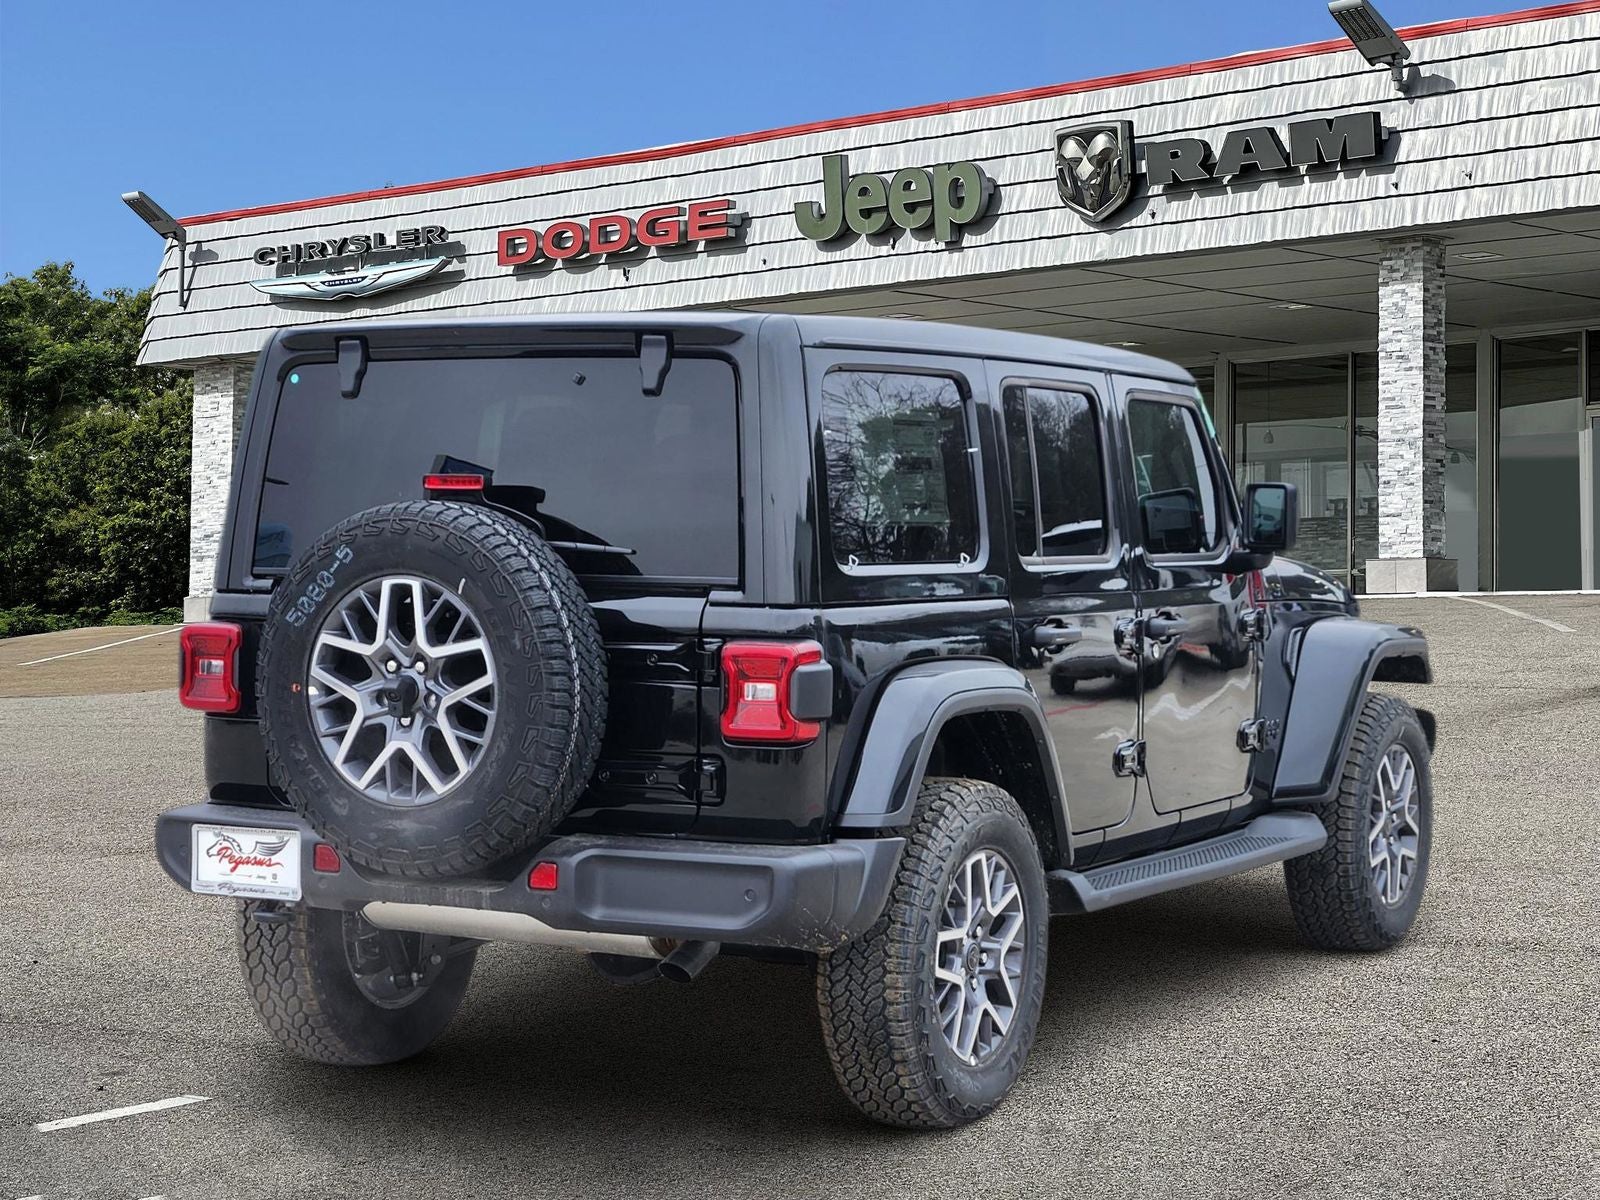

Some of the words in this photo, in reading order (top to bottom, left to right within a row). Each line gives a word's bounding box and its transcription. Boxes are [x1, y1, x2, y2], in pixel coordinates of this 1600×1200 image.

[1145, 111, 1381, 187] RAM
[795, 154, 988, 242] Jeep
[253, 224, 450, 267] CHRYSLER
[498, 199, 736, 267] DODGE
[217, 846, 284, 873] Pegasus
